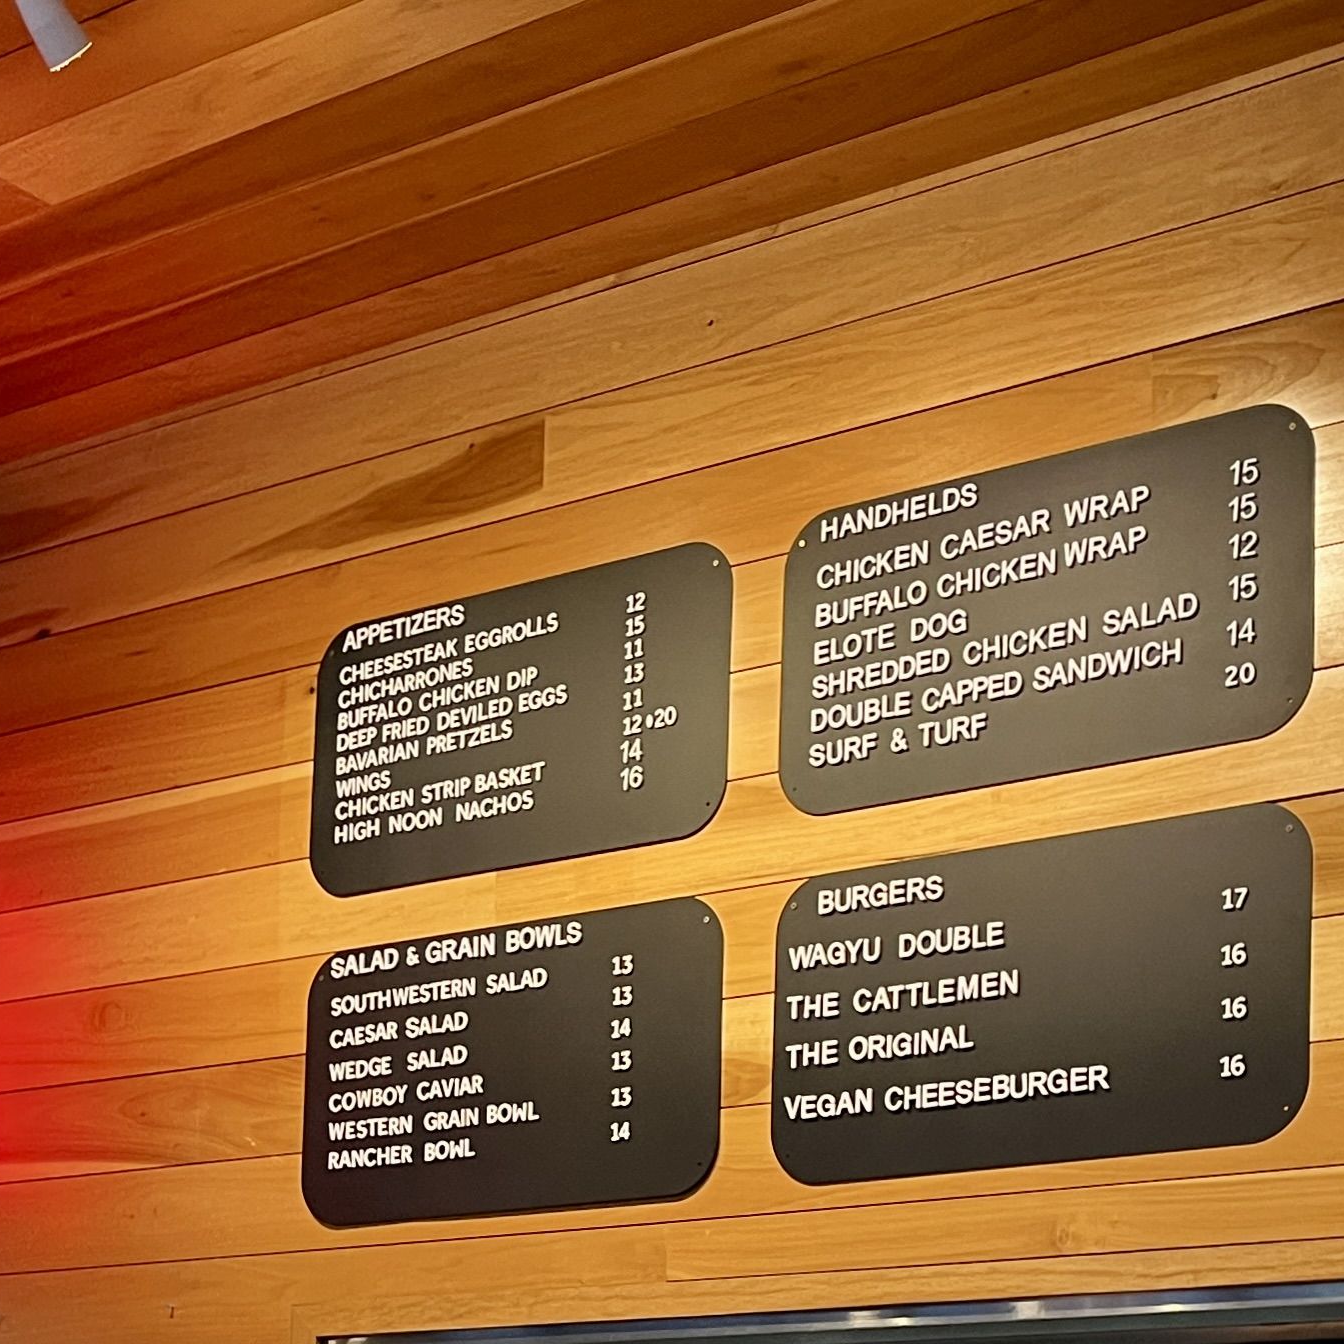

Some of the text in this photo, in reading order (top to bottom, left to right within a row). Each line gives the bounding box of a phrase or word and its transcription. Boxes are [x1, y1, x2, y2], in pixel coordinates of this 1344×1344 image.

[816, 457, 1258, 589] CHICKEN CAESAR WRAP 15
[820, 483, 978, 542] HANDHELDS
[813, 530, 1258, 665] ELOTE DOG 12
[814, 493, 1257, 628] BUFFALO CHICKEN WRAP 15
[337, 615, 645, 709] CHICHARRONES 15
[339, 592, 646, 686] CHEESESTEAK EGGROLLS 12
[342, 604, 465, 653] APPETIZERS
[811, 572, 1257, 699] SHREDDED CHICKEN SALAD 15
[336, 662, 644, 753] DEEP FRIED DEVILED EGGS 13
[337, 637, 644, 731] BUFFALO CHICKEN DIP 11
[810, 617, 1256, 733] DOUBLE CAPPED SANDWICH 14
[335, 688, 643, 776] BAVARIAN PRETZELS 11
[808, 662, 1255, 767] SURF & TURF 20
[334, 739, 643, 821] CHICKEN STRIP BASKET 14
[334, 765, 643, 844] HIGH NOON NACHOS 16
[335, 770, 391, 799] WINGS
[788, 887, 1248, 971] WAGYU DOUBLE 17
[817, 875, 944, 915] BURGERS
[330, 921, 583, 979] SALAD & GRAIN BOWLS
[330, 954, 634, 1017] SOUTHWESTERN SALAD 13
[786, 942, 1247, 1020] THE CATTLEMEN 16
[328, 1017, 631, 1082] WEDGE SALAD 14
[329, 985, 633, 1049] CAESAR SALAD 13
[785, 996, 1247, 1069] THE ORIGINAL 16
[328, 1050, 632, 1113] COWBOY CAVIAR 13
[328, 1086, 632, 1141] WESTERN GRAIN BOWL 13
[783, 1054, 1246, 1120] VEGAN CHEESEBURGER 16
[327, 1121, 631, 1170] RANCHER BOWL 14
